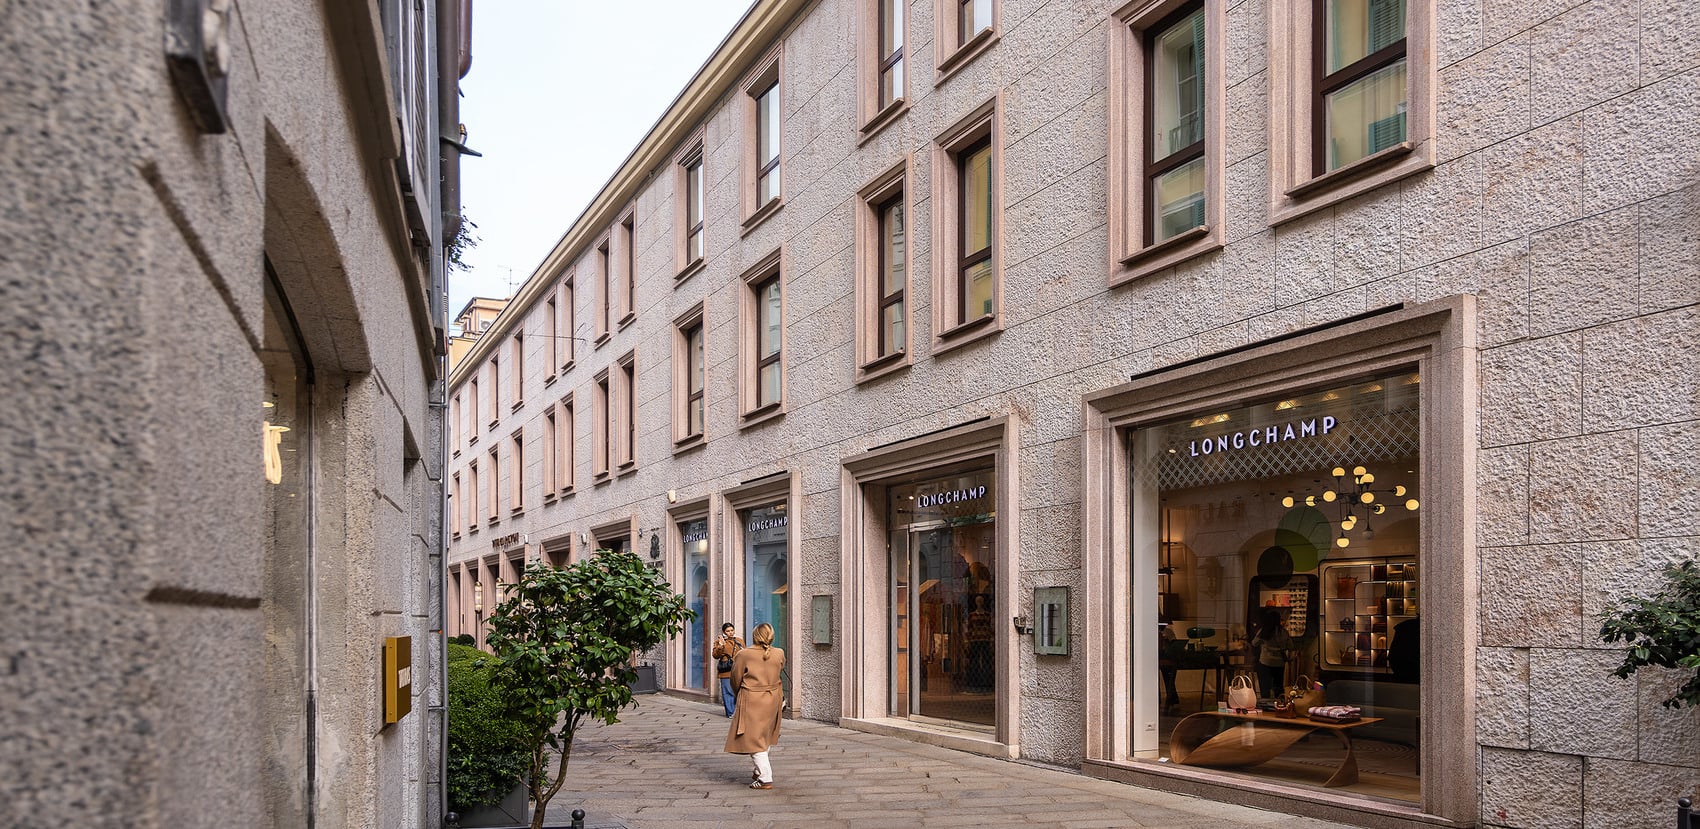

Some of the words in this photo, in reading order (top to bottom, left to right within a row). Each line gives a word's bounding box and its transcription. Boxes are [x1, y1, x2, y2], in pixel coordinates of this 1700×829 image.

[1190, 416, 1336, 457] LONGCHAMP
[917, 485, 986, 508] LONGCHAMP
[748, 516, 788, 532] LONGCHAMP
